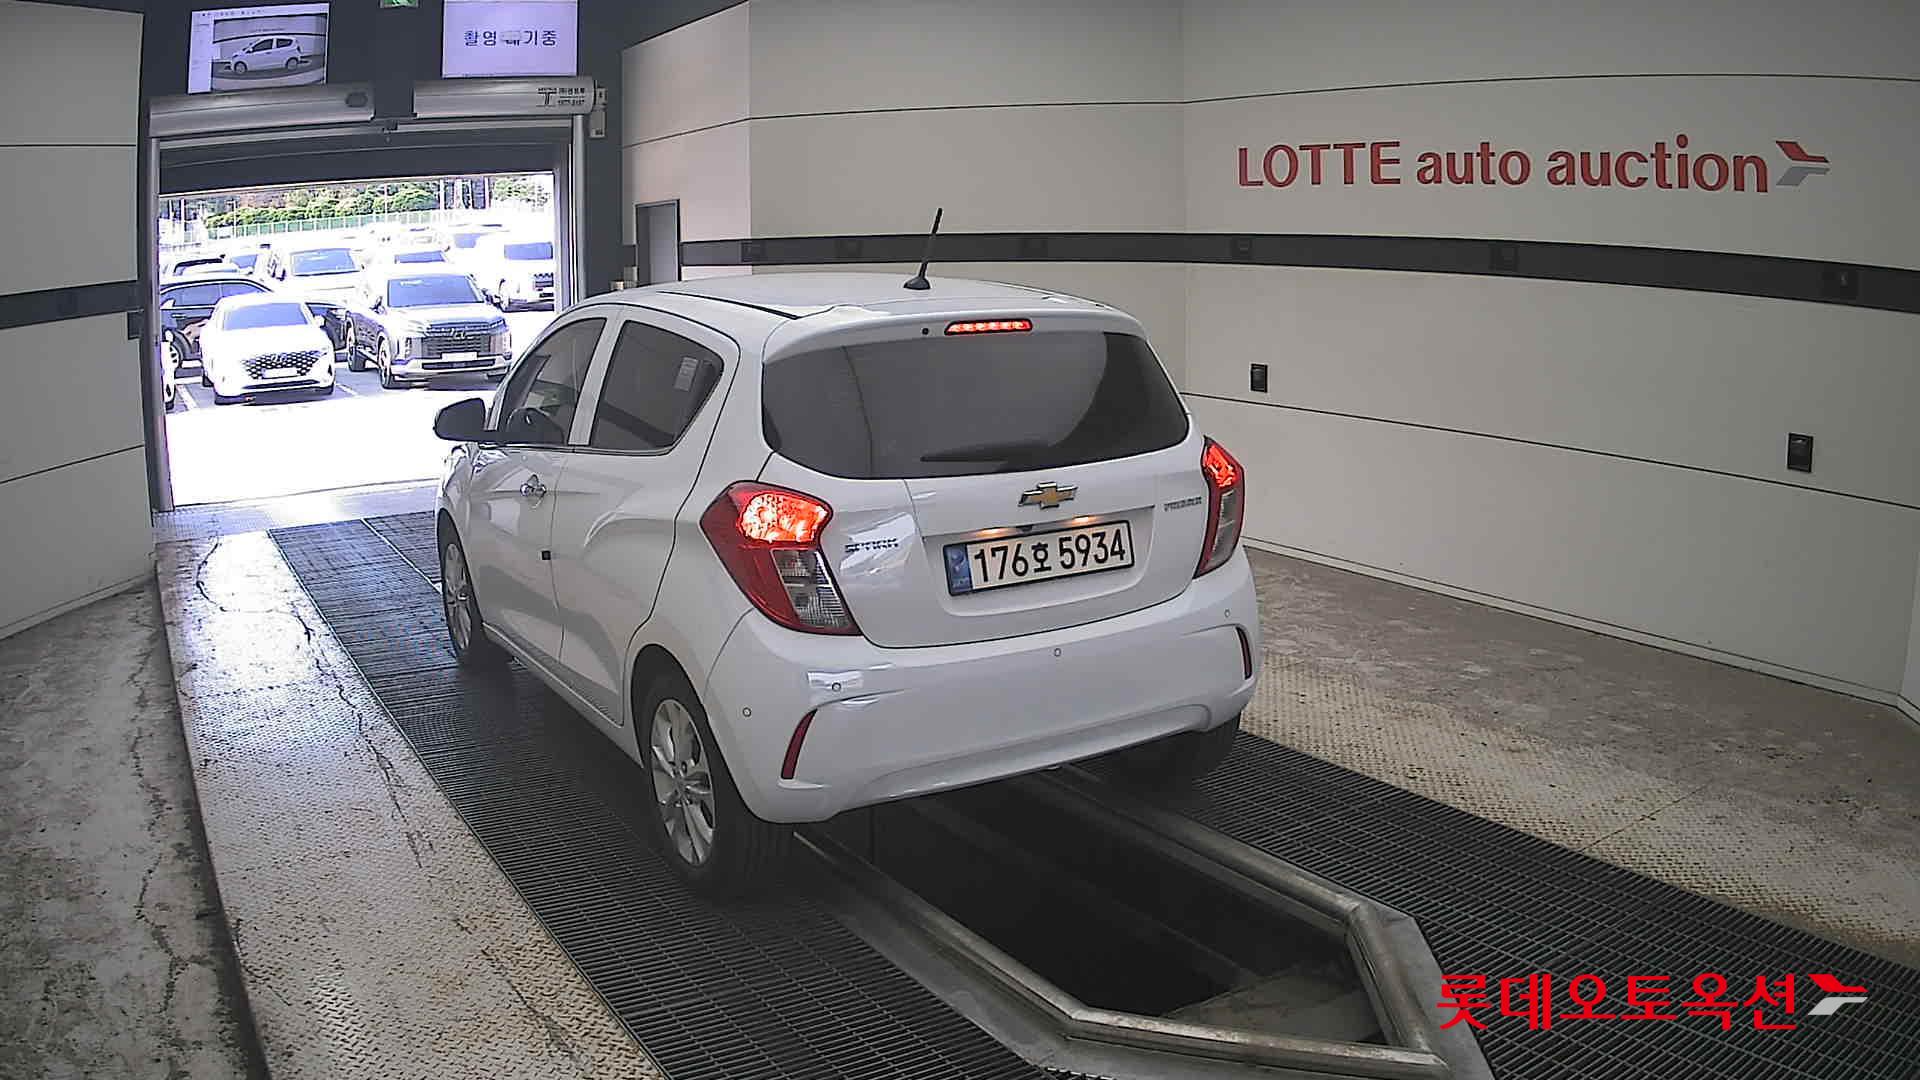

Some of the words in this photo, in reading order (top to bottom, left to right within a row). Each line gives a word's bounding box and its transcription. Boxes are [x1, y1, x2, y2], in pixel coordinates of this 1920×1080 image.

[1238, 141, 1401, 188] LOTTE
[1416, 141, 1532, 187] auto
[1546, 134, 1769, 193] auction
[974, 541, 1052, 583] 176호
[1058, 528, 1126, 570] 5934
